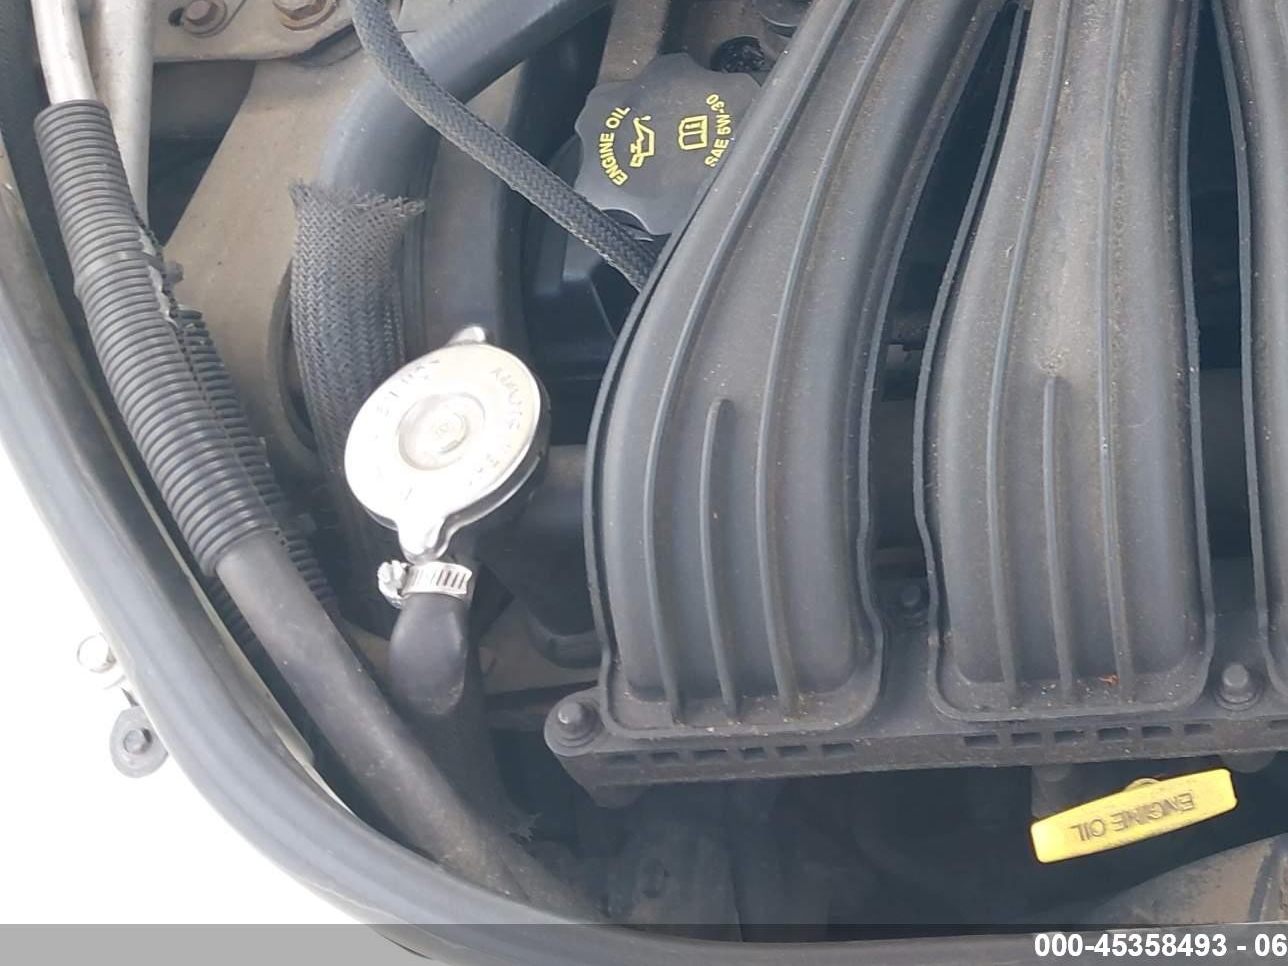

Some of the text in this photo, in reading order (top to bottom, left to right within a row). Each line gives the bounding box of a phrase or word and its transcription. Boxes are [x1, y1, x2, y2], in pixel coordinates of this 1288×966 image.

[599, 106, 631, 186] ENGINE OIL
[704, 94, 731, 167] SAE 5W-30
[1069, 791, 1196, 842] ENGINE OIL
